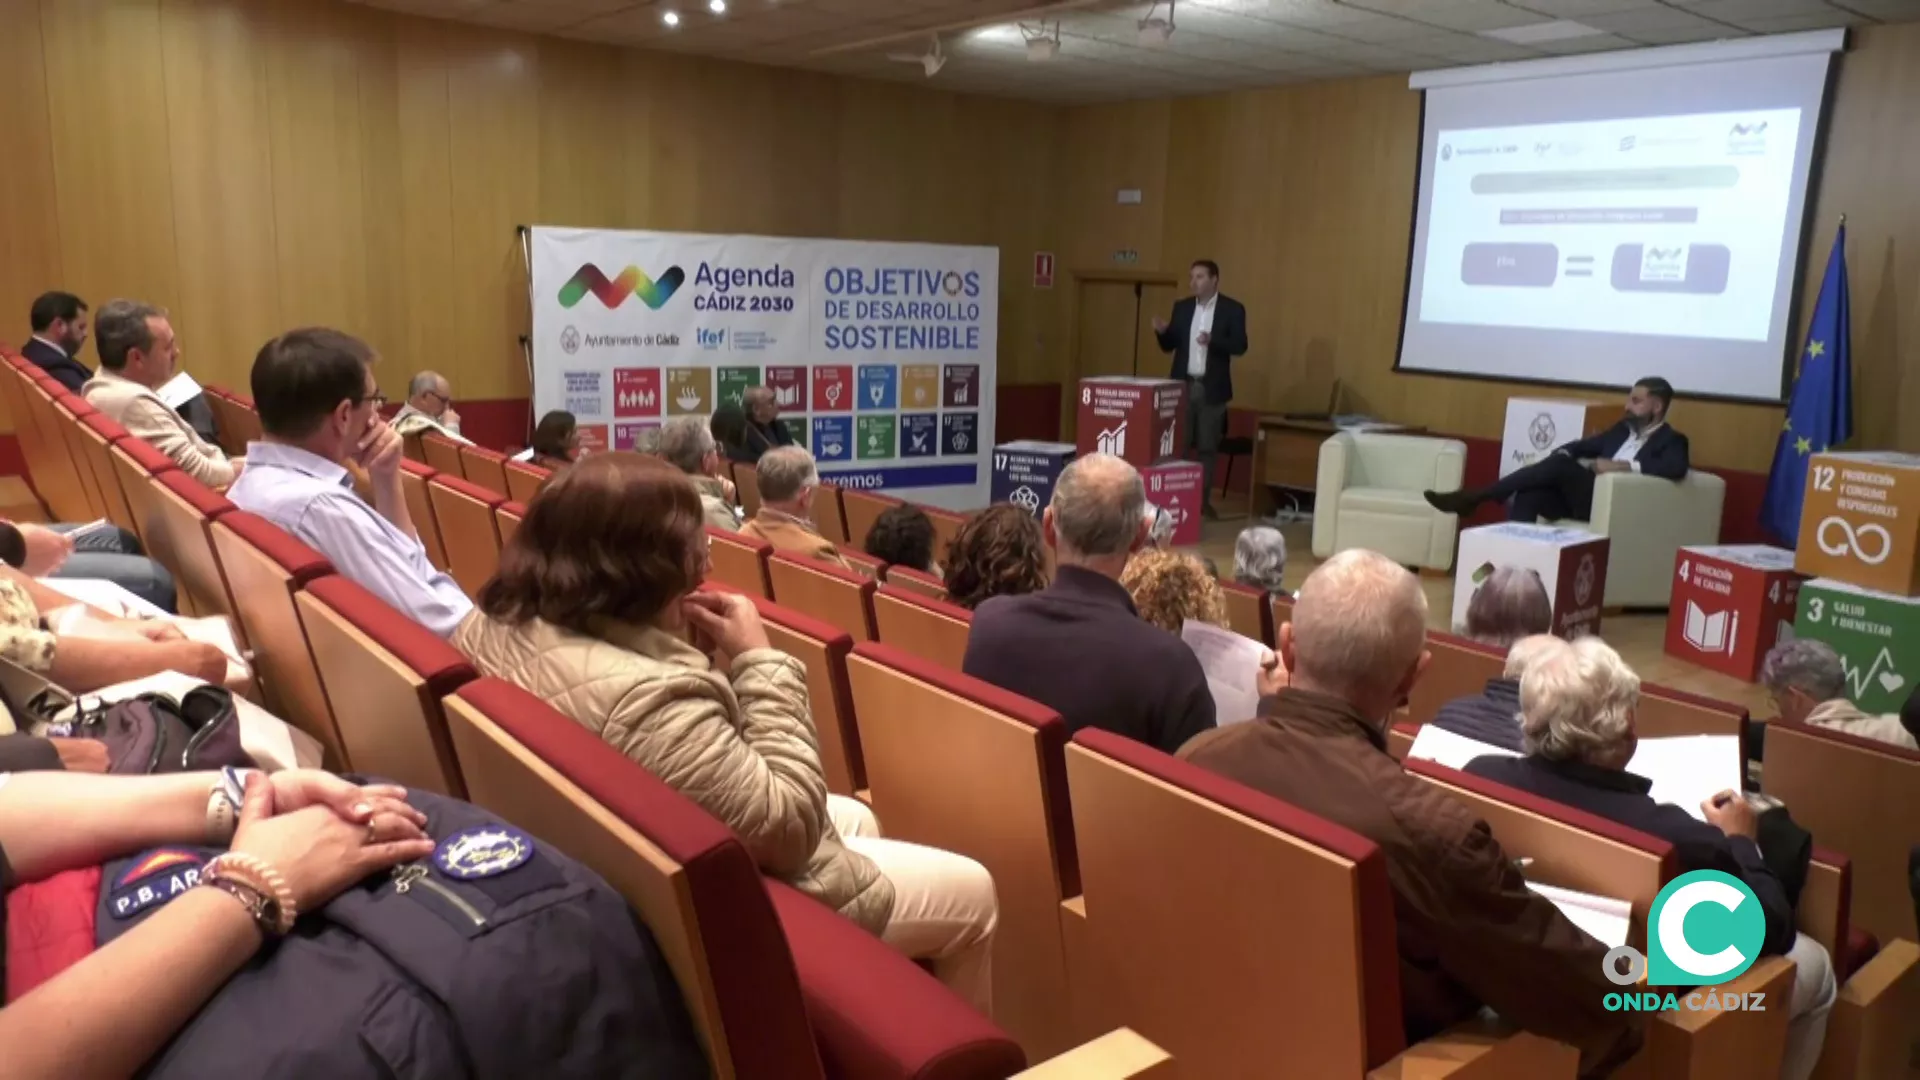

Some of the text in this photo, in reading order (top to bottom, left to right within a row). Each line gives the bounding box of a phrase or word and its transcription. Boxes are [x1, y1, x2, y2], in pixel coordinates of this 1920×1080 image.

[694, 261, 795, 292] Agenda
[824, 267, 980, 297] OBJETIVOS
[694, 291, 795, 313] CÁDIZ 2030
[824, 300, 980, 321] DE DESARROLLO
[584, 330, 680, 349] Ayuntamiento de Cádiz
[696, 327, 726, 345] ifef
[824, 325, 980, 350] SOSTENIBLE
[1082, 387, 1091, 405] 8
[616, 427, 627, 438] 10
[995, 454, 1008, 471] 17
[1150, 474, 1162, 493] 10
[1812, 465, 1836, 492] 12
[1841, 468, 1896, 488] PRODUCCIÓN
[1839, 484, 1888, 502] Y CONSUMO
[1836, 497, 1899, 519] RESPONSABLES
[1678, 558, 1690, 583] 4
[1695, 563, 1734, 582] EDUCACIÓN
[1693, 577, 1732, 597] DE CALIDAD
[1768, 580, 1780, 605] 4
[1806, 597, 1825, 623] 3
[1833, 600, 1866, 617] SALUD
[1830, 615, 1893, 638] Y BIENESTAR
[116, 885, 163, 913] P.B.
